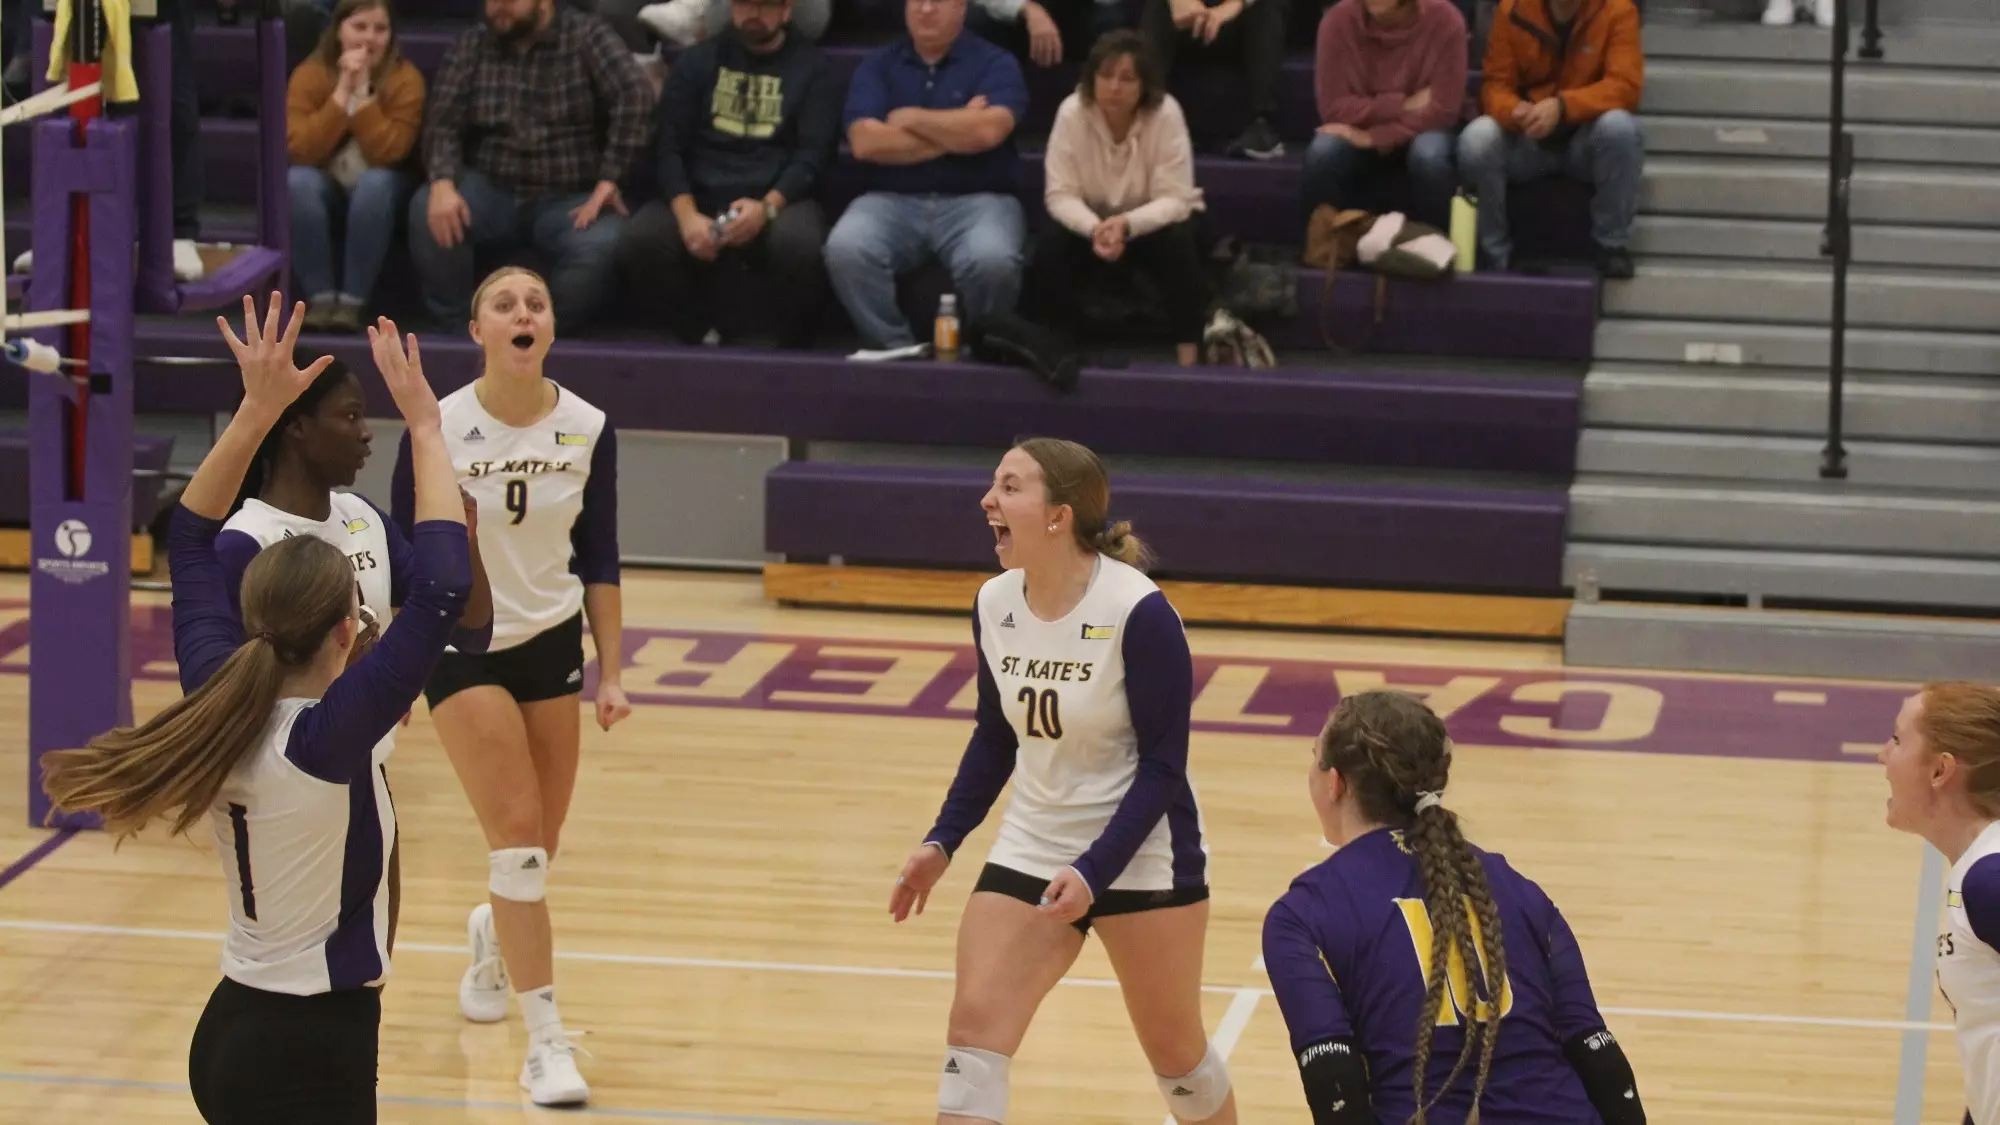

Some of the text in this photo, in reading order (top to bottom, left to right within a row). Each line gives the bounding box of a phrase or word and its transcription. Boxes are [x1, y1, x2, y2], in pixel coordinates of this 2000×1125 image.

[506, 479, 527, 526] 9
[346, 550, 377, 572] TE'S
[1001, 655, 1093, 682] ST. KATE'S
[1017, 685, 1063, 740] 20
[227, 801, 258, 923] 1
[1391, 892, 1513, 1027] 10
